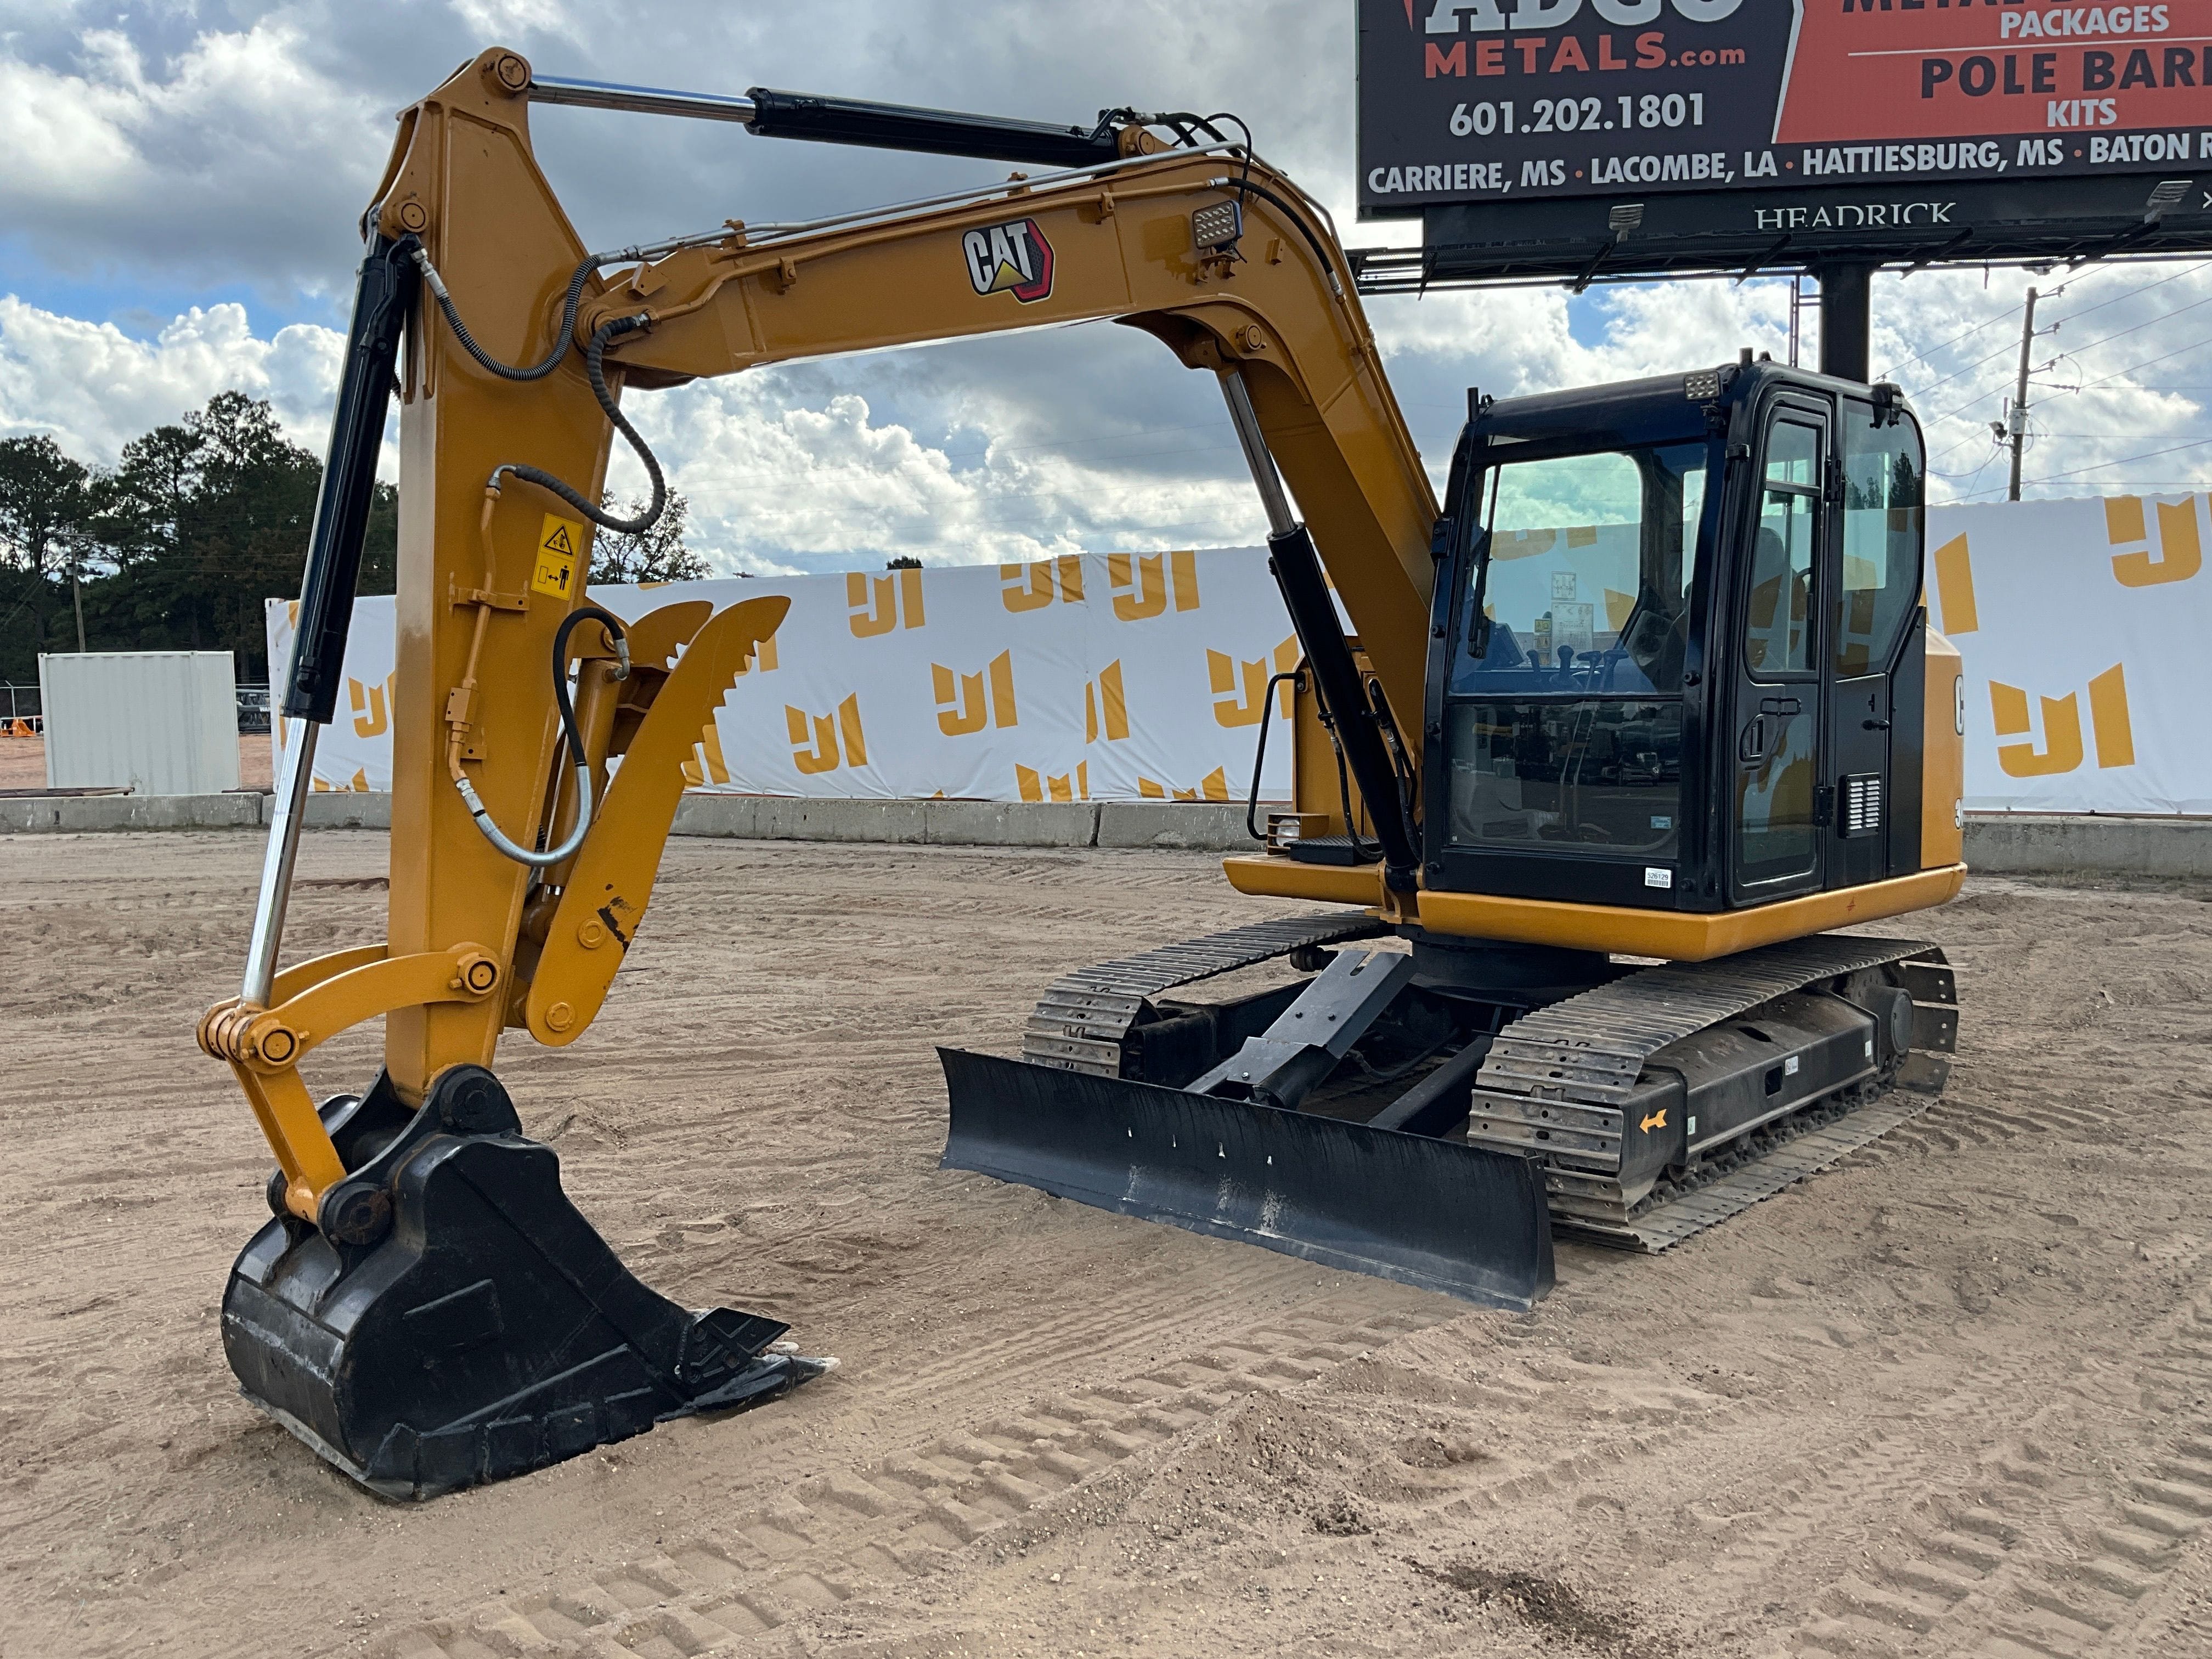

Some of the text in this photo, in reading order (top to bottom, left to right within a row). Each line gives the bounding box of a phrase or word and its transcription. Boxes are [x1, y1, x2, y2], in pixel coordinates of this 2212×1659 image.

[2000, 4, 2170, 38] PACKAGES
[1425, 32, 1746, 78] METALS.com
[1921, 46, 2212, 99] POLE BAR
[1449, 93, 1703, 137] 601.202.1801
[2047, 98, 2118, 128] KITS
[1368, 162, 1511, 194] CARRIERE,
[1520, 159, 1566, 187] MS
[1592, 153, 1736, 184] LACOMBE,
[1744, 150, 1778, 177] LA
[1803, 141, 2008, 176] HATTIESBURG,
[2016, 138, 2064, 167] MS
[2090, 133, 2190, 163] BATON
[1754, 202, 1956, 229] HEADRICK
[964, 222, 1034, 292] CAT
